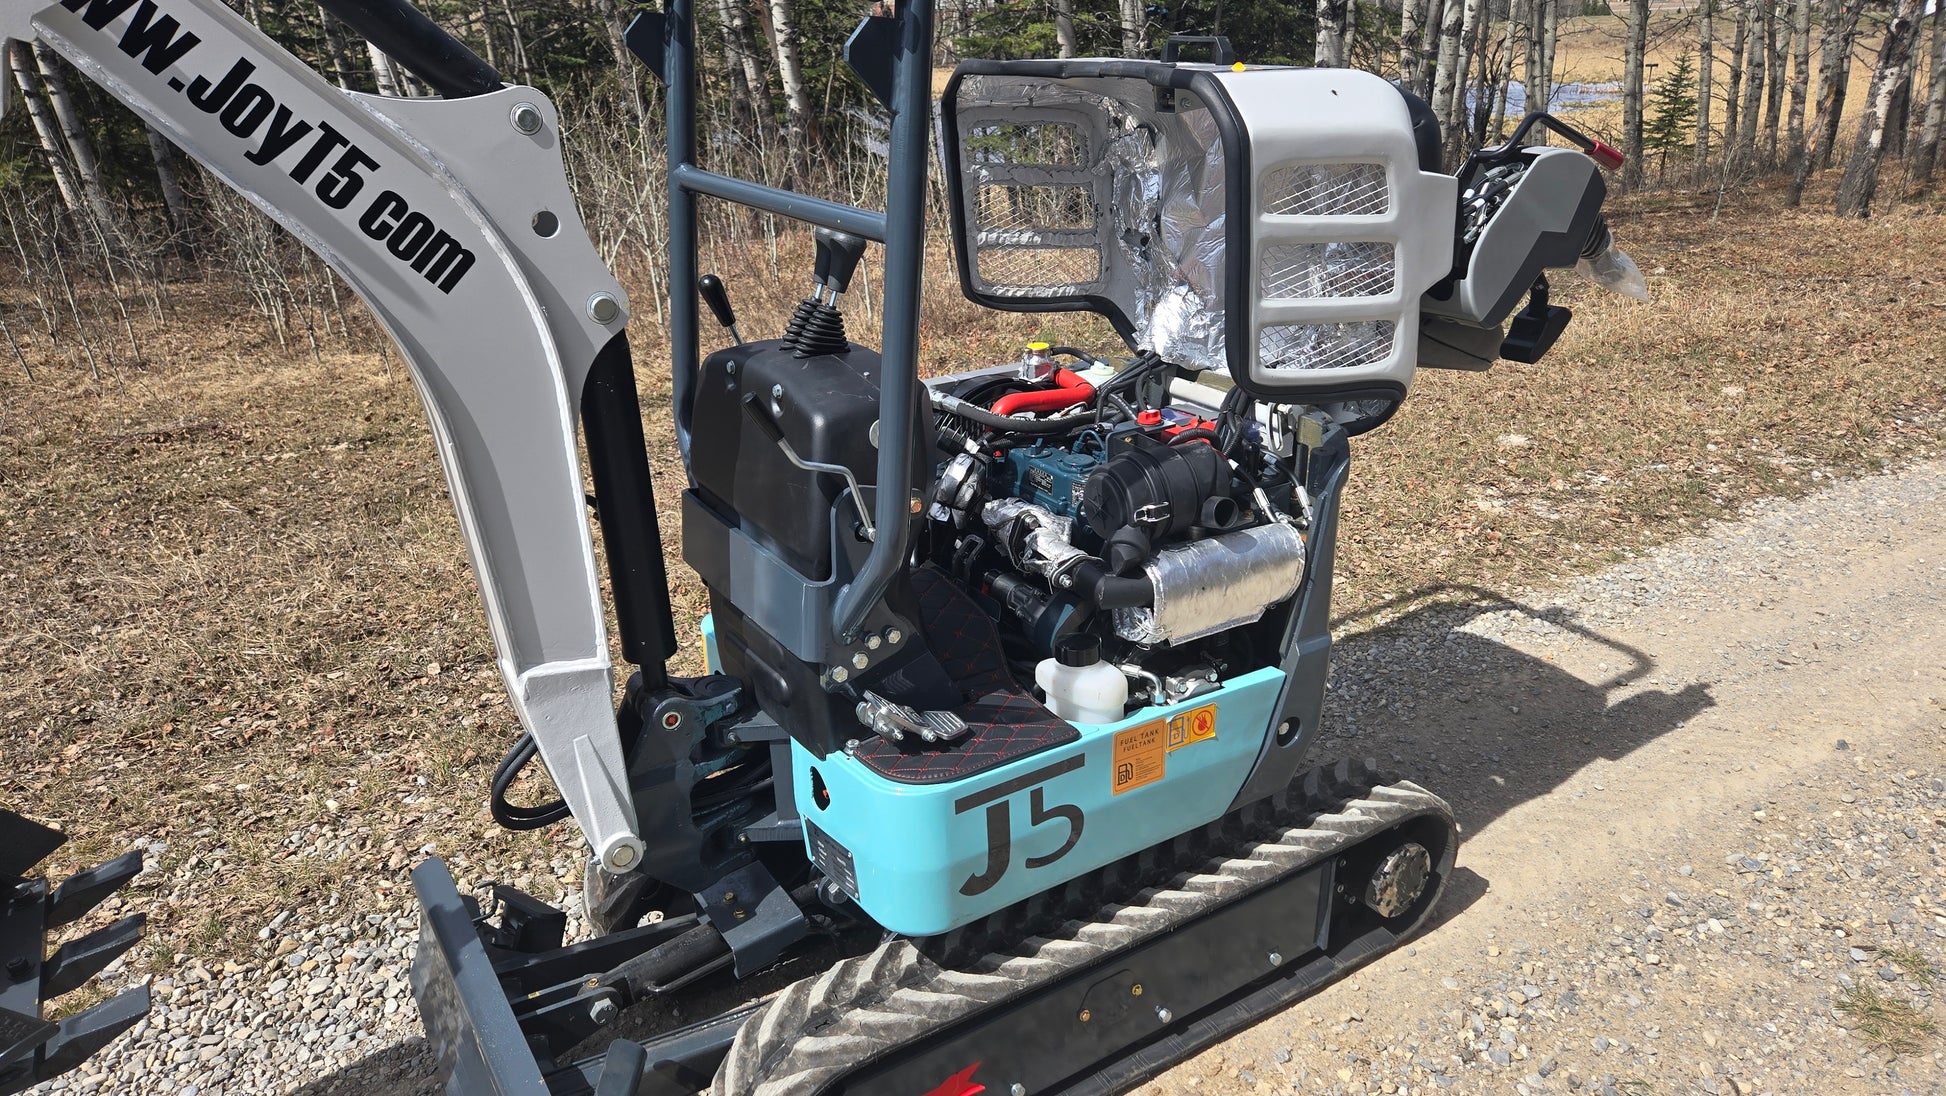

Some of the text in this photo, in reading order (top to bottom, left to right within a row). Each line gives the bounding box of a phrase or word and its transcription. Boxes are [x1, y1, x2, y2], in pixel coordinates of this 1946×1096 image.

[358, 189, 476, 295] com
[1120, 729, 1160, 746] FUEL TANK
[1123, 737, 1156, 752] FUELTANK
